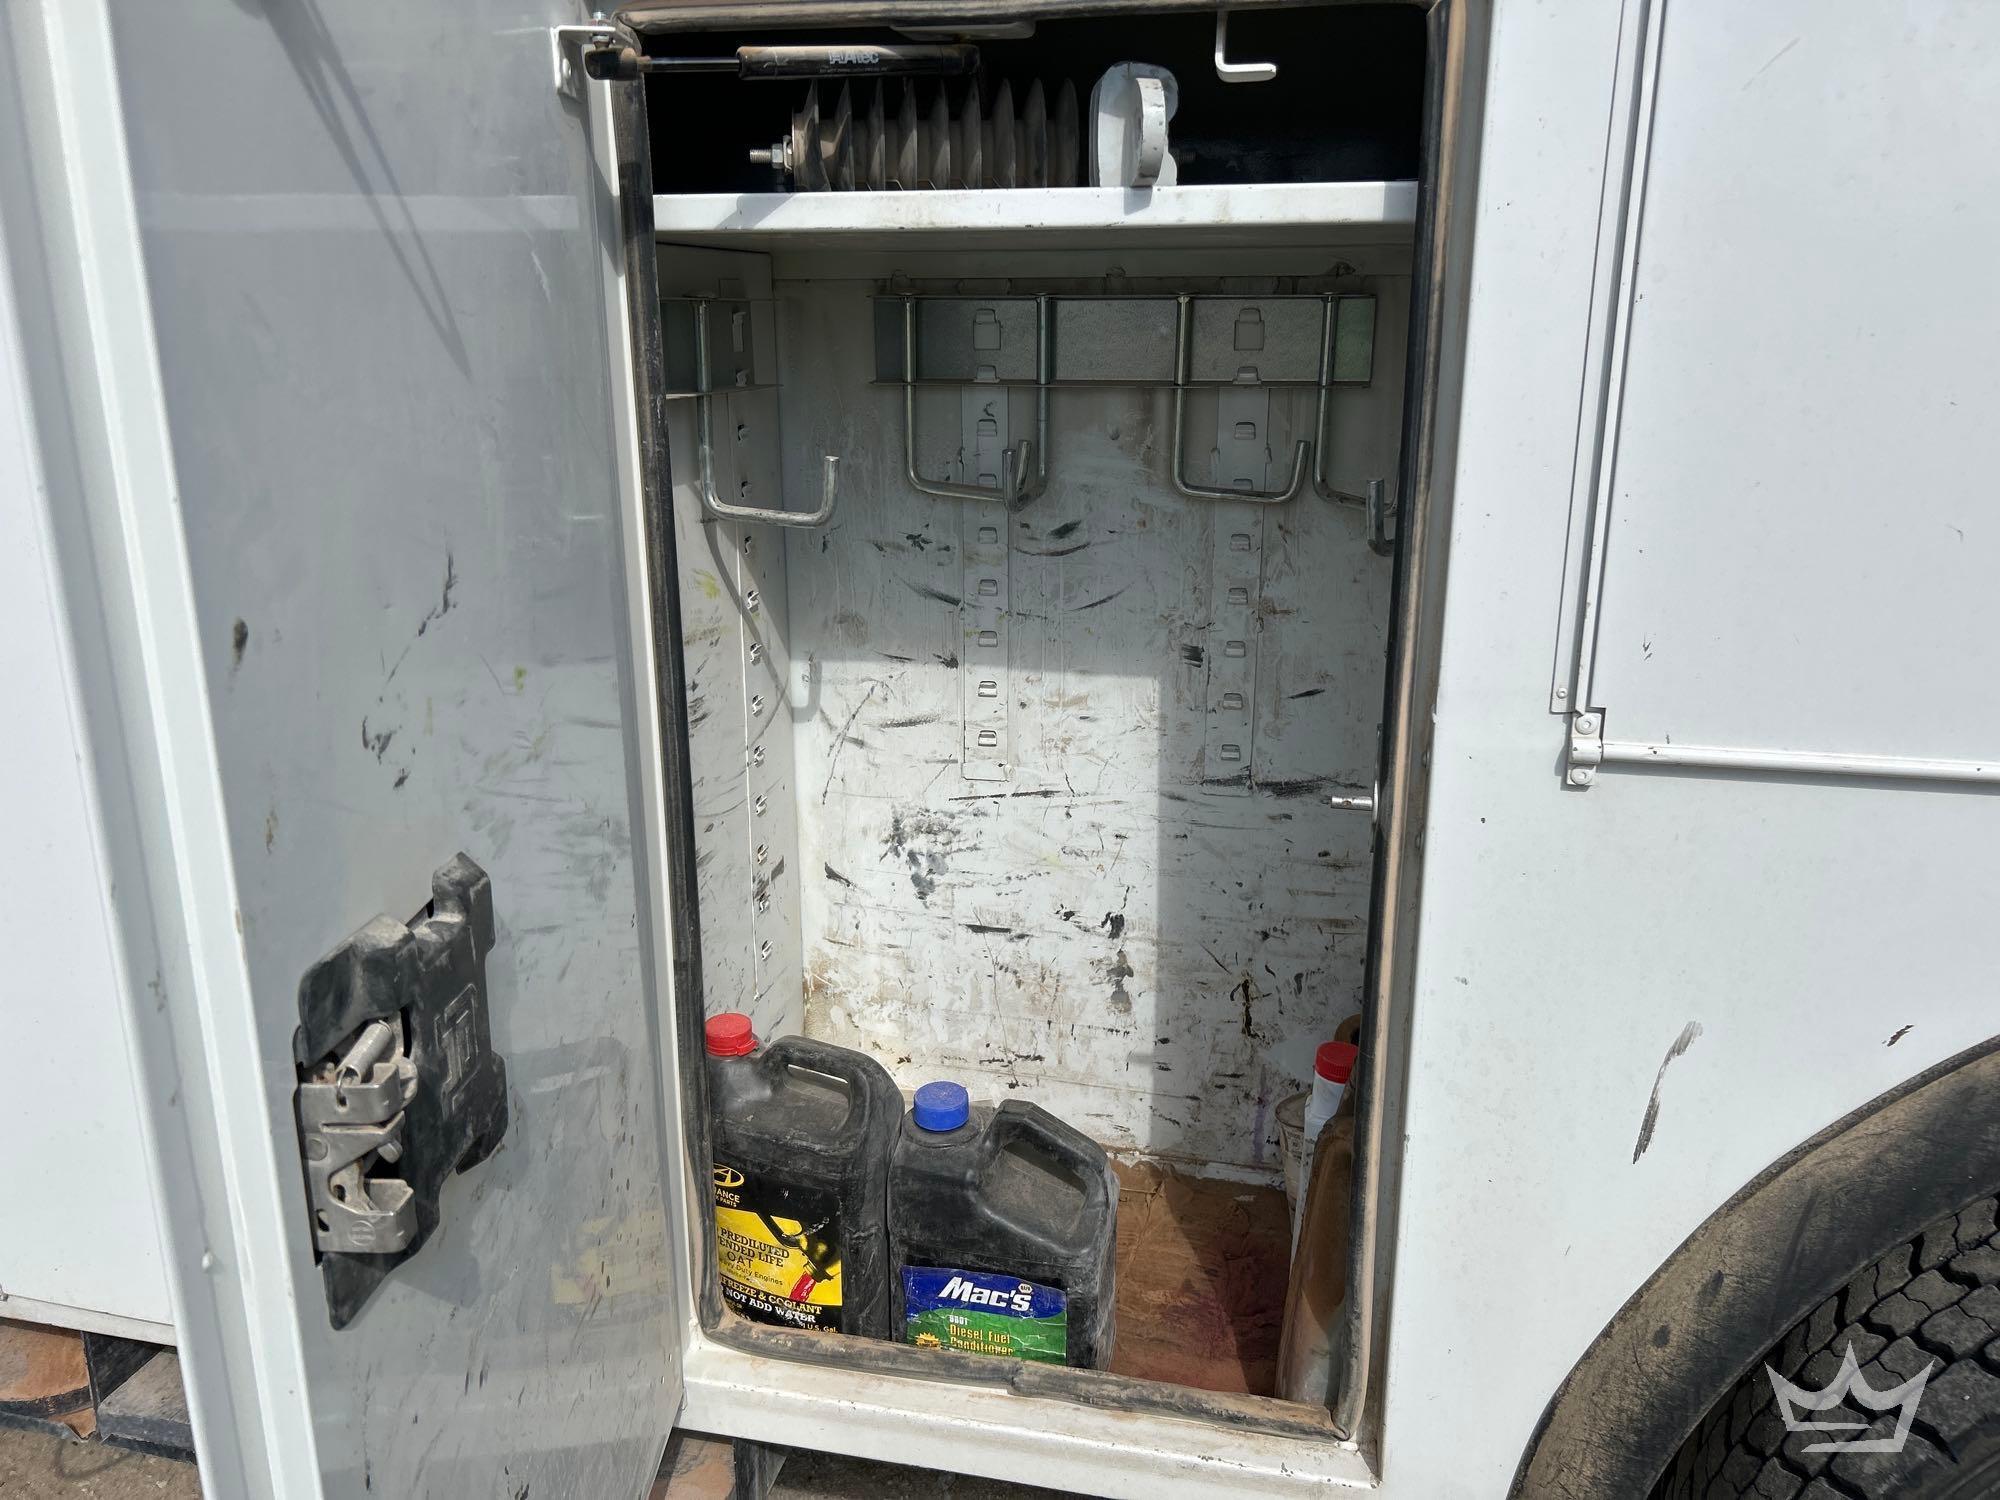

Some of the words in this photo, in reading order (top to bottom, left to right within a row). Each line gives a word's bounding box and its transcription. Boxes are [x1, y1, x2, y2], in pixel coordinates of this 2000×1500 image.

[714, 1187, 740, 1203] ANCE
[718, 1235, 756, 1258] ENDED
[758, 1251, 784, 1268] LIFE
[720, 1227, 790, 1259] PREDILUTED
[727, 1251, 754, 1269] OAT
[736, 1264, 753, 1277] Duty
[754, 1271, 784, 1286] Engines
[726, 1287, 748, 1303] NOT
[749, 1298, 773, 1312] ADD
[774, 1306, 817, 1323] WATER
[758, 1291, 767, 1302] &
[768, 1295, 823, 1315] COOLANT
[938, 1276, 1032, 1312] Mac's
[949, 1324, 983, 1341] Diesel
[988, 1331, 1011, 1344] Fuel
[950, 1336, 1014, 1356] Conditioner
